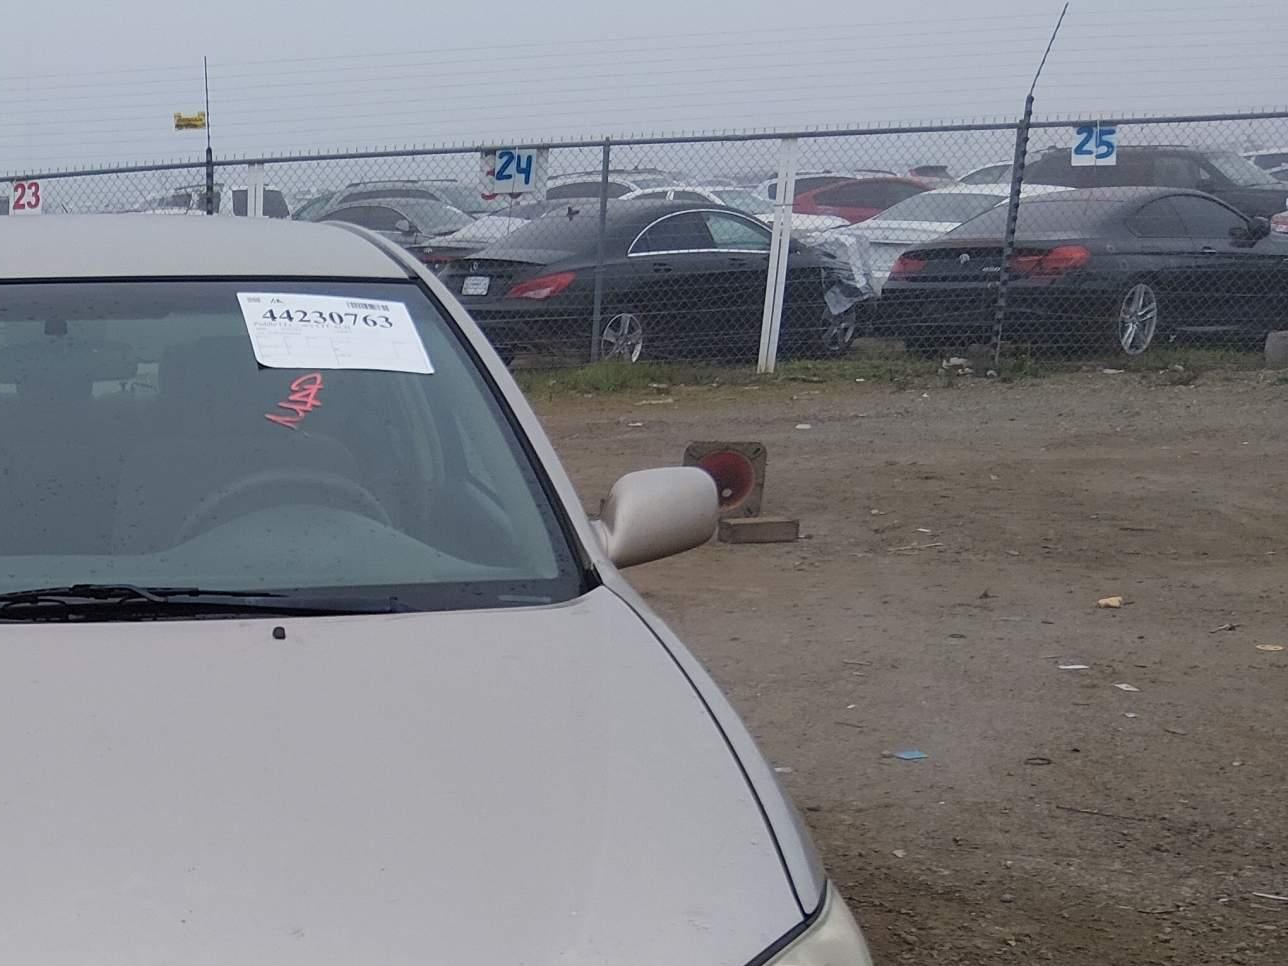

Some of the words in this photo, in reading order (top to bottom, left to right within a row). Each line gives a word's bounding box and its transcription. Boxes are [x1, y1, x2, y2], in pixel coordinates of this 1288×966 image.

[1074, 126, 1115, 159] 25
[496, 151, 532, 185] 24
[14, 182, 40, 209] 23
[262, 308, 394, 329] 44230763
